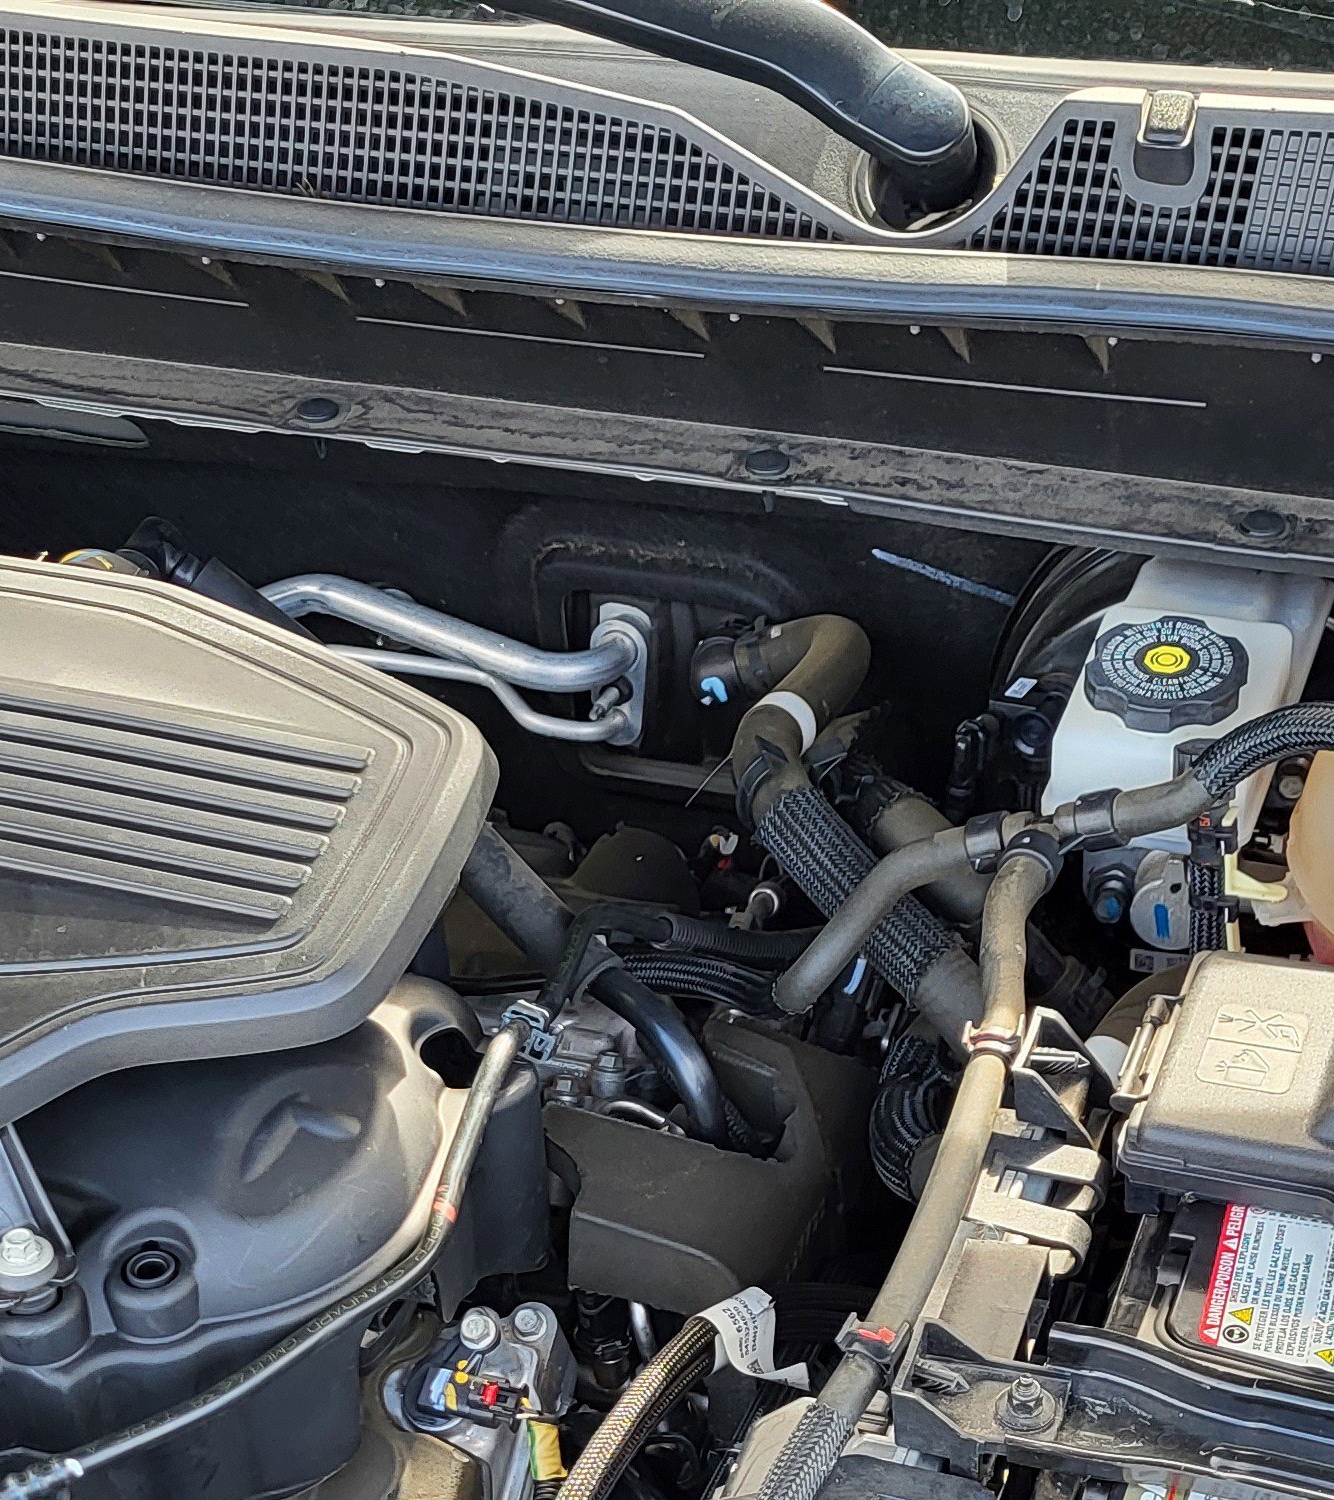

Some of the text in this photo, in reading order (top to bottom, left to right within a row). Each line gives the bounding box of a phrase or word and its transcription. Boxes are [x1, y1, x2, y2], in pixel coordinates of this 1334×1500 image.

[1176, 621, 1212, 637] BOUCHON
[1272, 1223, 1286, 1254] EXPLOSIFS
[1269, 1255, 1279, 1268] GAZ
[1267, 1268, 1277, 1280] LES
[1289, 1261, 1300, 1282] GASES
[1207, 1251, 1235, 1326] DANGER/POISON
[1239, 1283, 1251, 1304] GASES
[1286, 1283, 1296, 1295] LOS
[1321, 1288, 1330, 1300] CAN
[1261, 1298, 1270, 1309] LES
[1280, 1314, 1289, 1326] LOS
[1264, 1327, 1276, 1352] PEUVENT
[1274, 1326, 1287, 1354] PROTEJA
[1285, 1318, 1300, 1356] EXPLOSIVOS
[1252, 1341, 1261, 1350] SE
